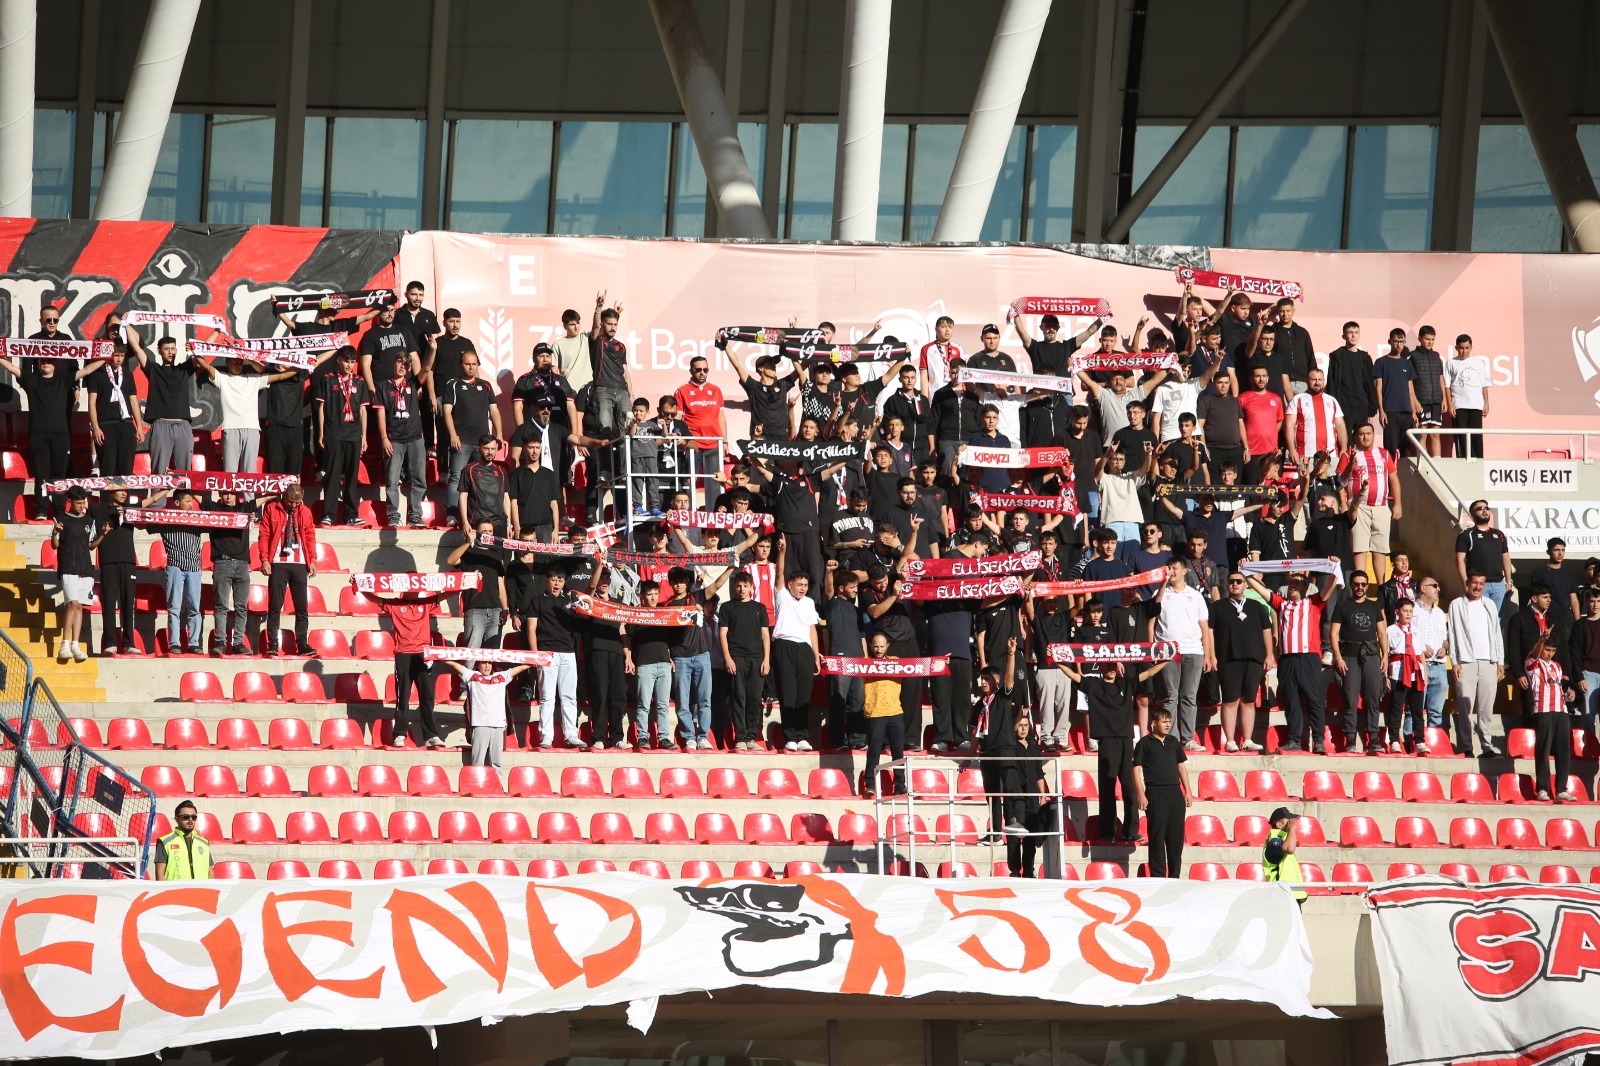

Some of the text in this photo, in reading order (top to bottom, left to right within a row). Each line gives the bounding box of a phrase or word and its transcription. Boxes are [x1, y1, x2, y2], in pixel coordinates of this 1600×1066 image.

[508, 255, 536, 295] E
[1027, 301, 1097, 314] Sivasspor
[746, 440, 858, 460] Soldiers of Allah
[1489, 469, 1528, 486] ÇIKIŞ
[1540, 470, 1572, 483] EXIT
[990, 496, 1055, 509] SİVASSPOR
[951, 556, 1022, 575] ELLİSEKİZ
[933, 886, 1169, 985] 58
